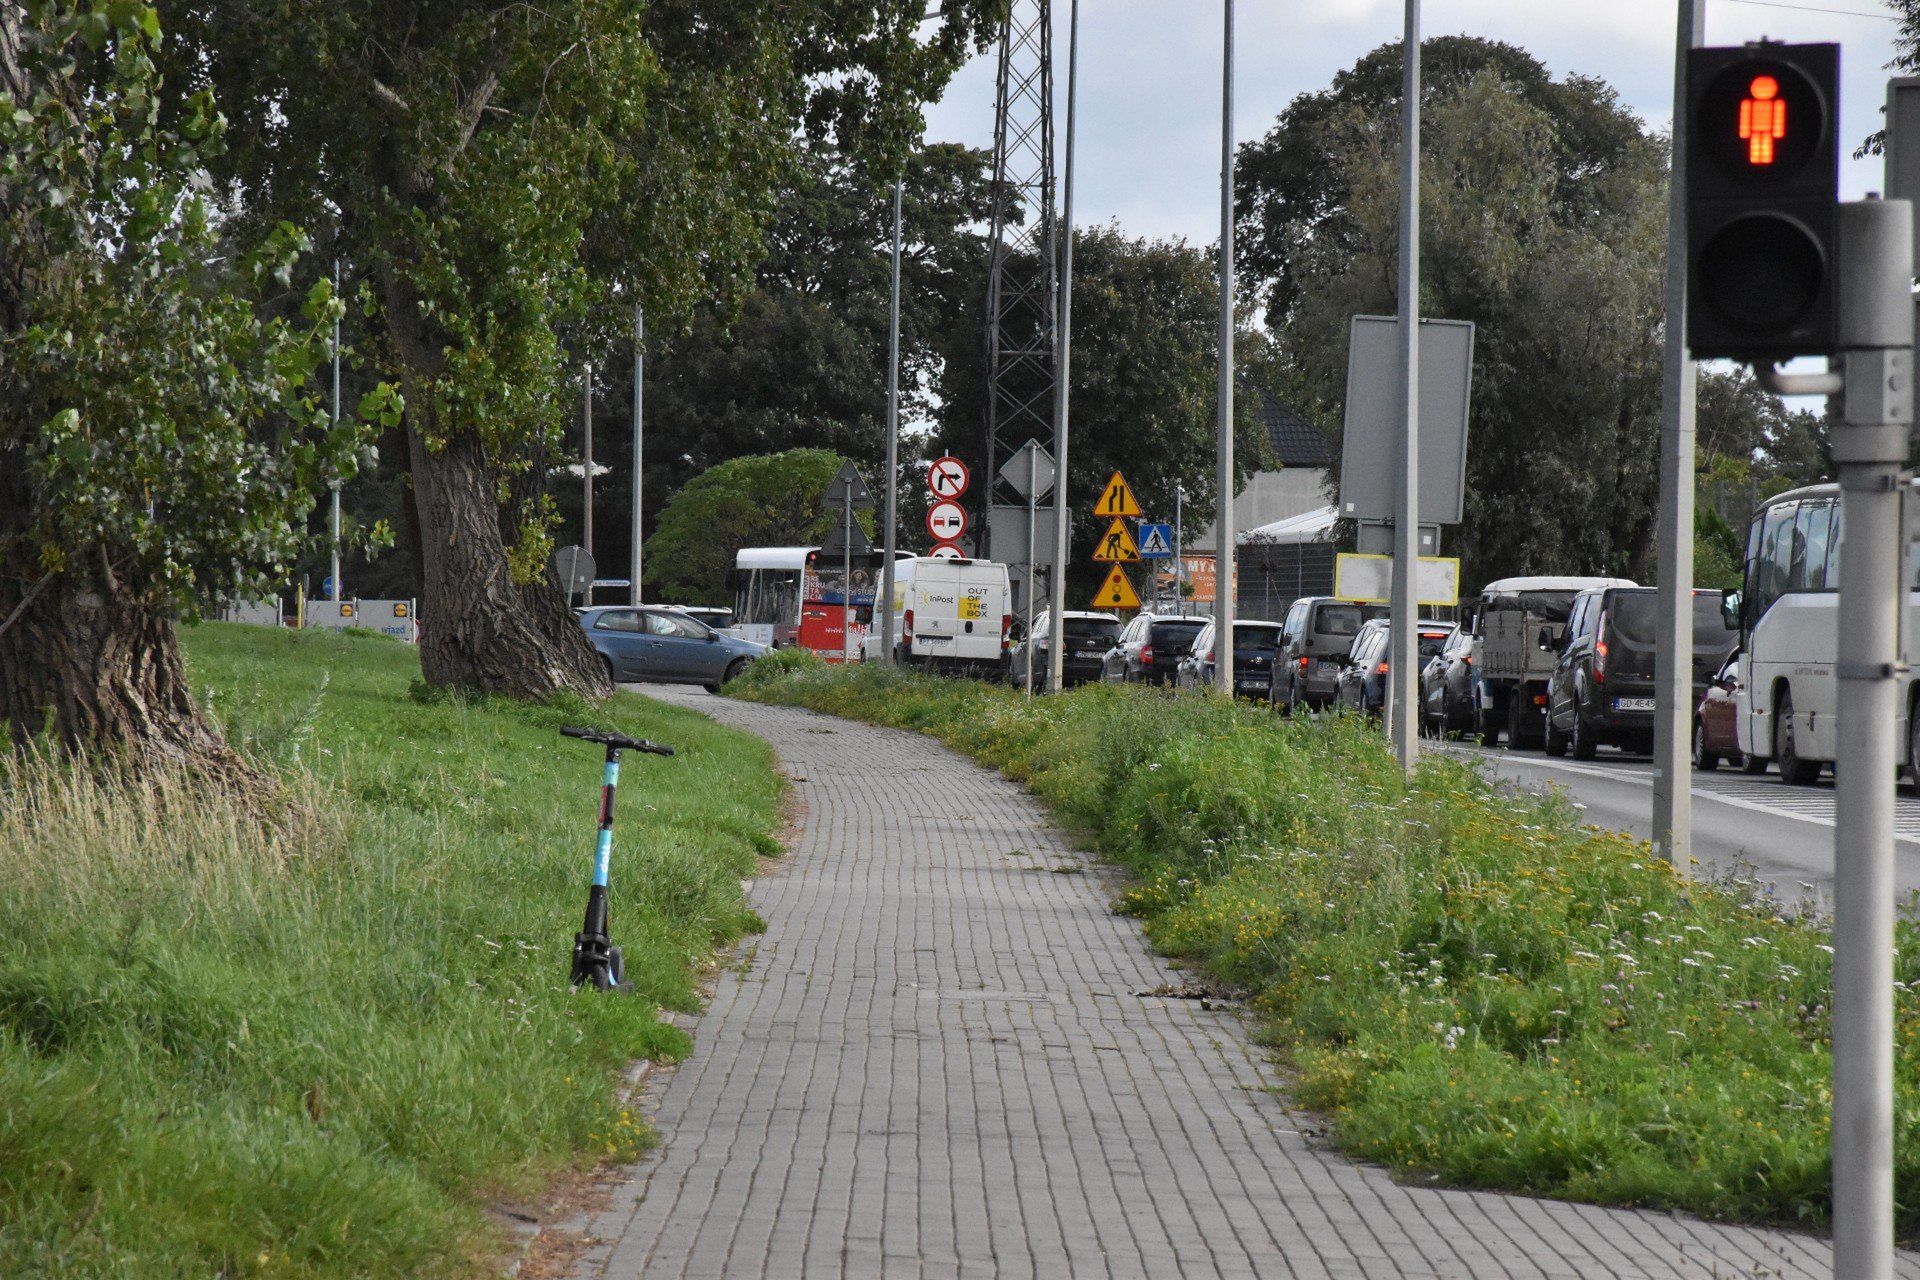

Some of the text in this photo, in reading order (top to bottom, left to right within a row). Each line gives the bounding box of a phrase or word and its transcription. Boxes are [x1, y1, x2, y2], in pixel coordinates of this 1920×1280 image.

[968, 587, 988, 595] OUT
[929, 595, 954, 603] InPost
[967, 602, 988, 610] THE
[966, 610, 988, 618] BOX
[1621, 699, 1656, 708] GD 4E45
